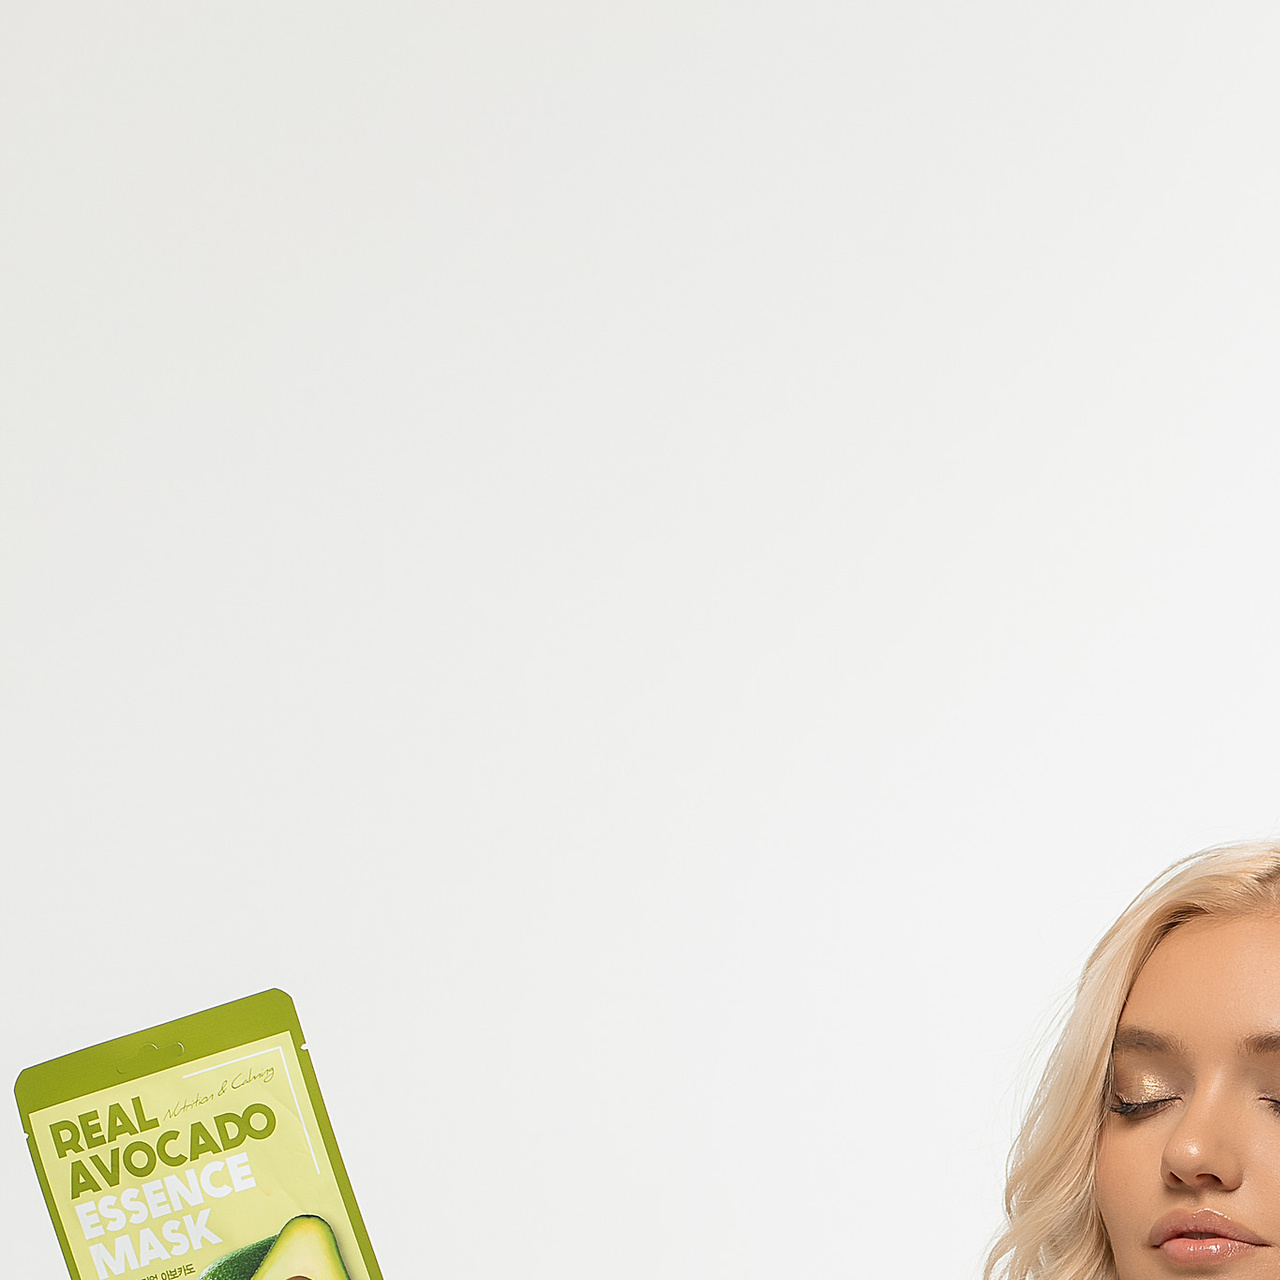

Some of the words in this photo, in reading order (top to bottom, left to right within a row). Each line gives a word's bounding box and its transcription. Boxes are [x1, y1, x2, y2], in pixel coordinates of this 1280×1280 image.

[231, 1066, 275, 1089] Calming
[49, 1096, 160, 1158] REAL
[71, 1103, 276, 1200] AVOCADO
[75, 1152, 257, 1240] ESSENCE
[89, 1208, 223, 1280] MASK
